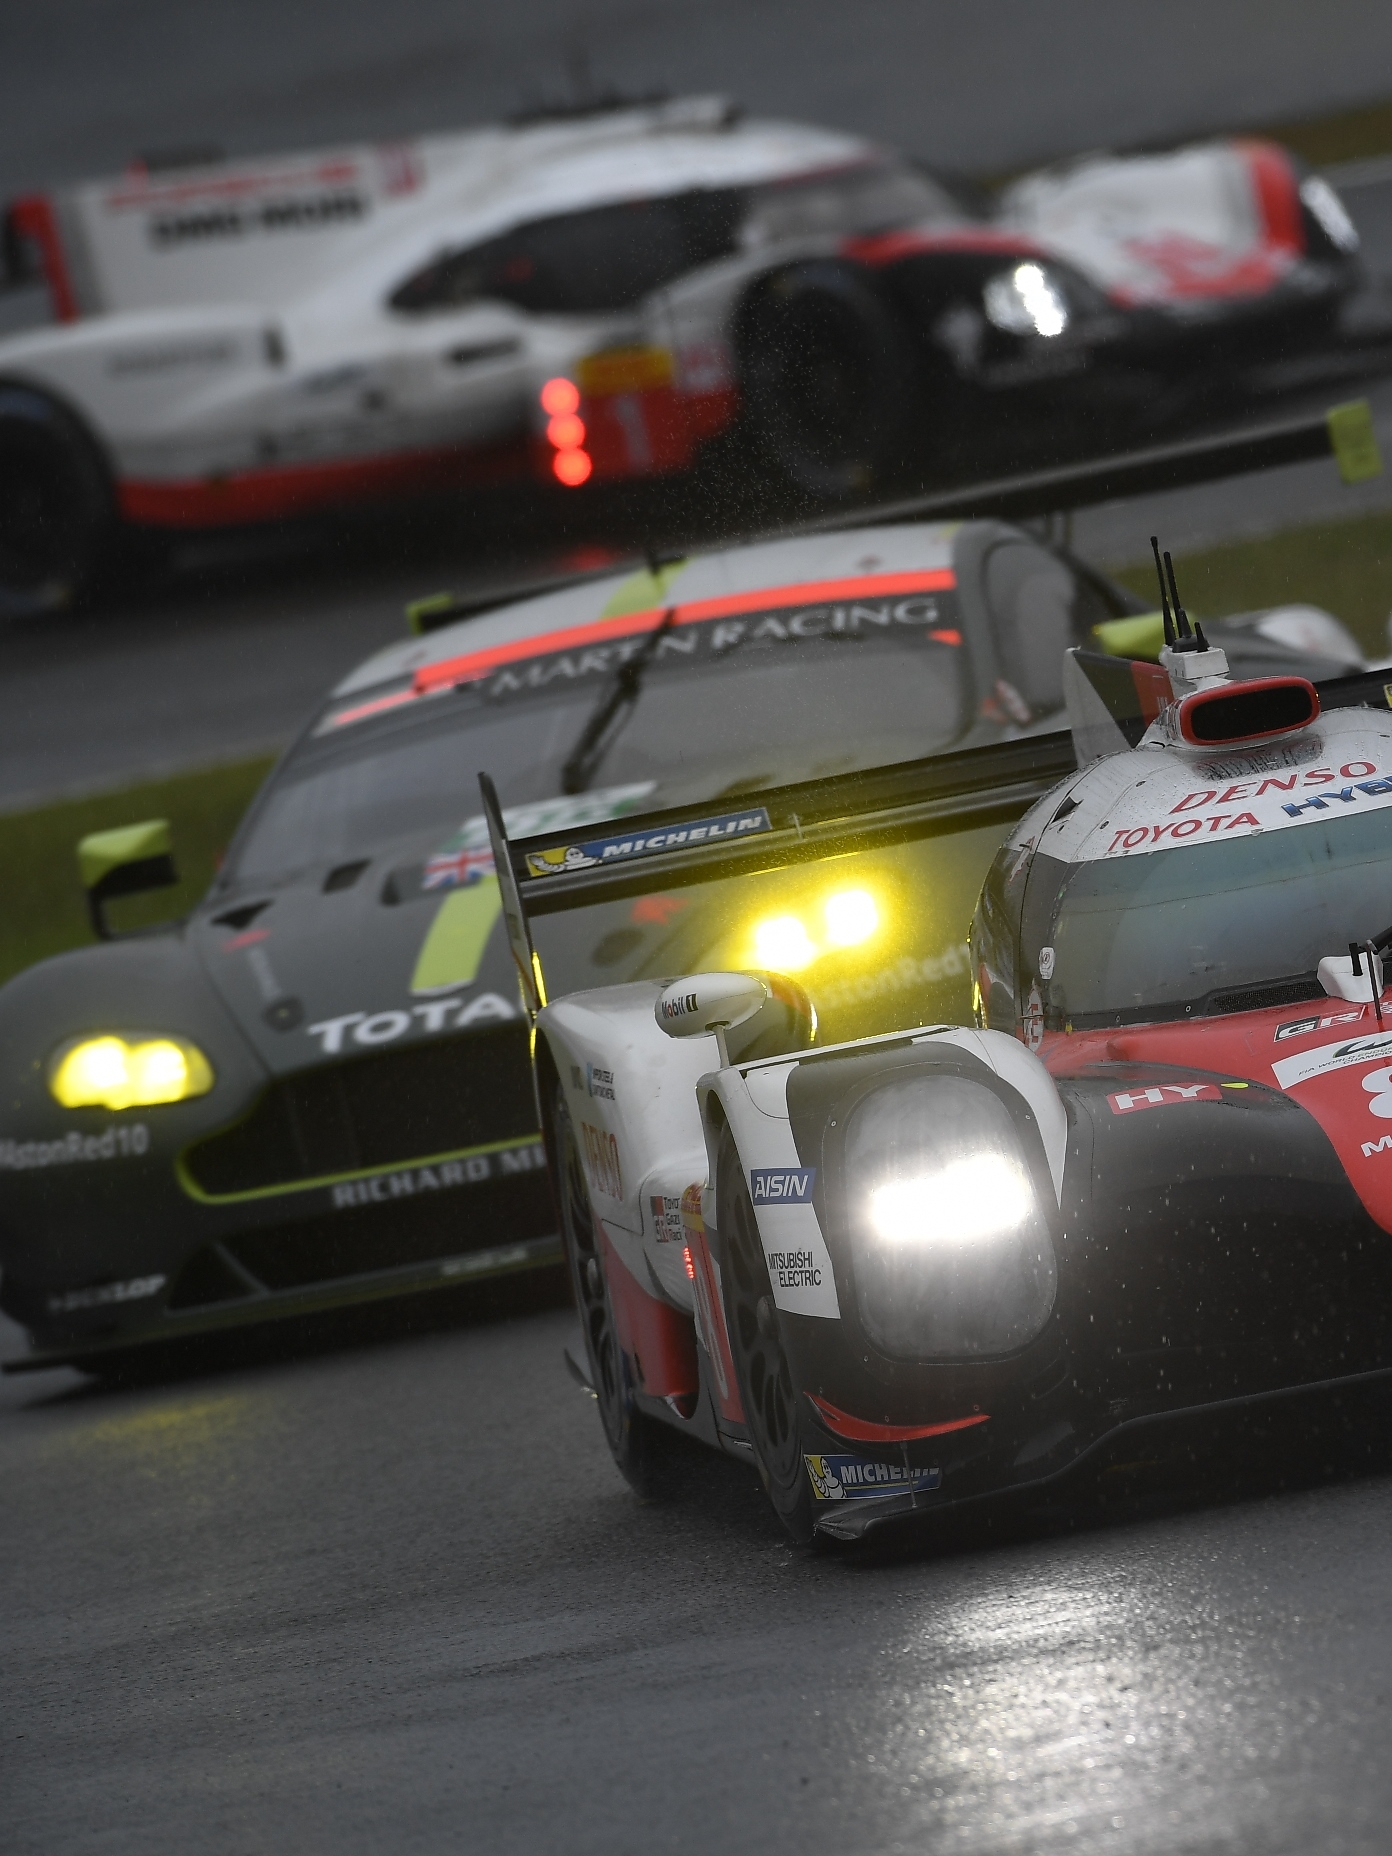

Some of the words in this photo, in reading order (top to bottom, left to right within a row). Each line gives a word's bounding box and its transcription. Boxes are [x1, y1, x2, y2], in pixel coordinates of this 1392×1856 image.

[491, 631, 699, 697] MARTN
[711, 600, 938, 649] RACING
[1168, 760, 1377, 814] DENSO
[602, 816, 762, 857] MICHELIN
[1107, 812, 1262, 852] TOYOTA
[307, 992, 527, 1054] TOTA
[661, 996, 686, 1019] Mobil
[1114, 1084, 1209, 1110] HY
[331, 1156, 491, 1210] RICHARD
[754, 1174, 809, 1199] AISIN
[768, 1250, 814, 1270] MITSUBISHI
[778, 1268, 822, 1288] ELECTRIC
